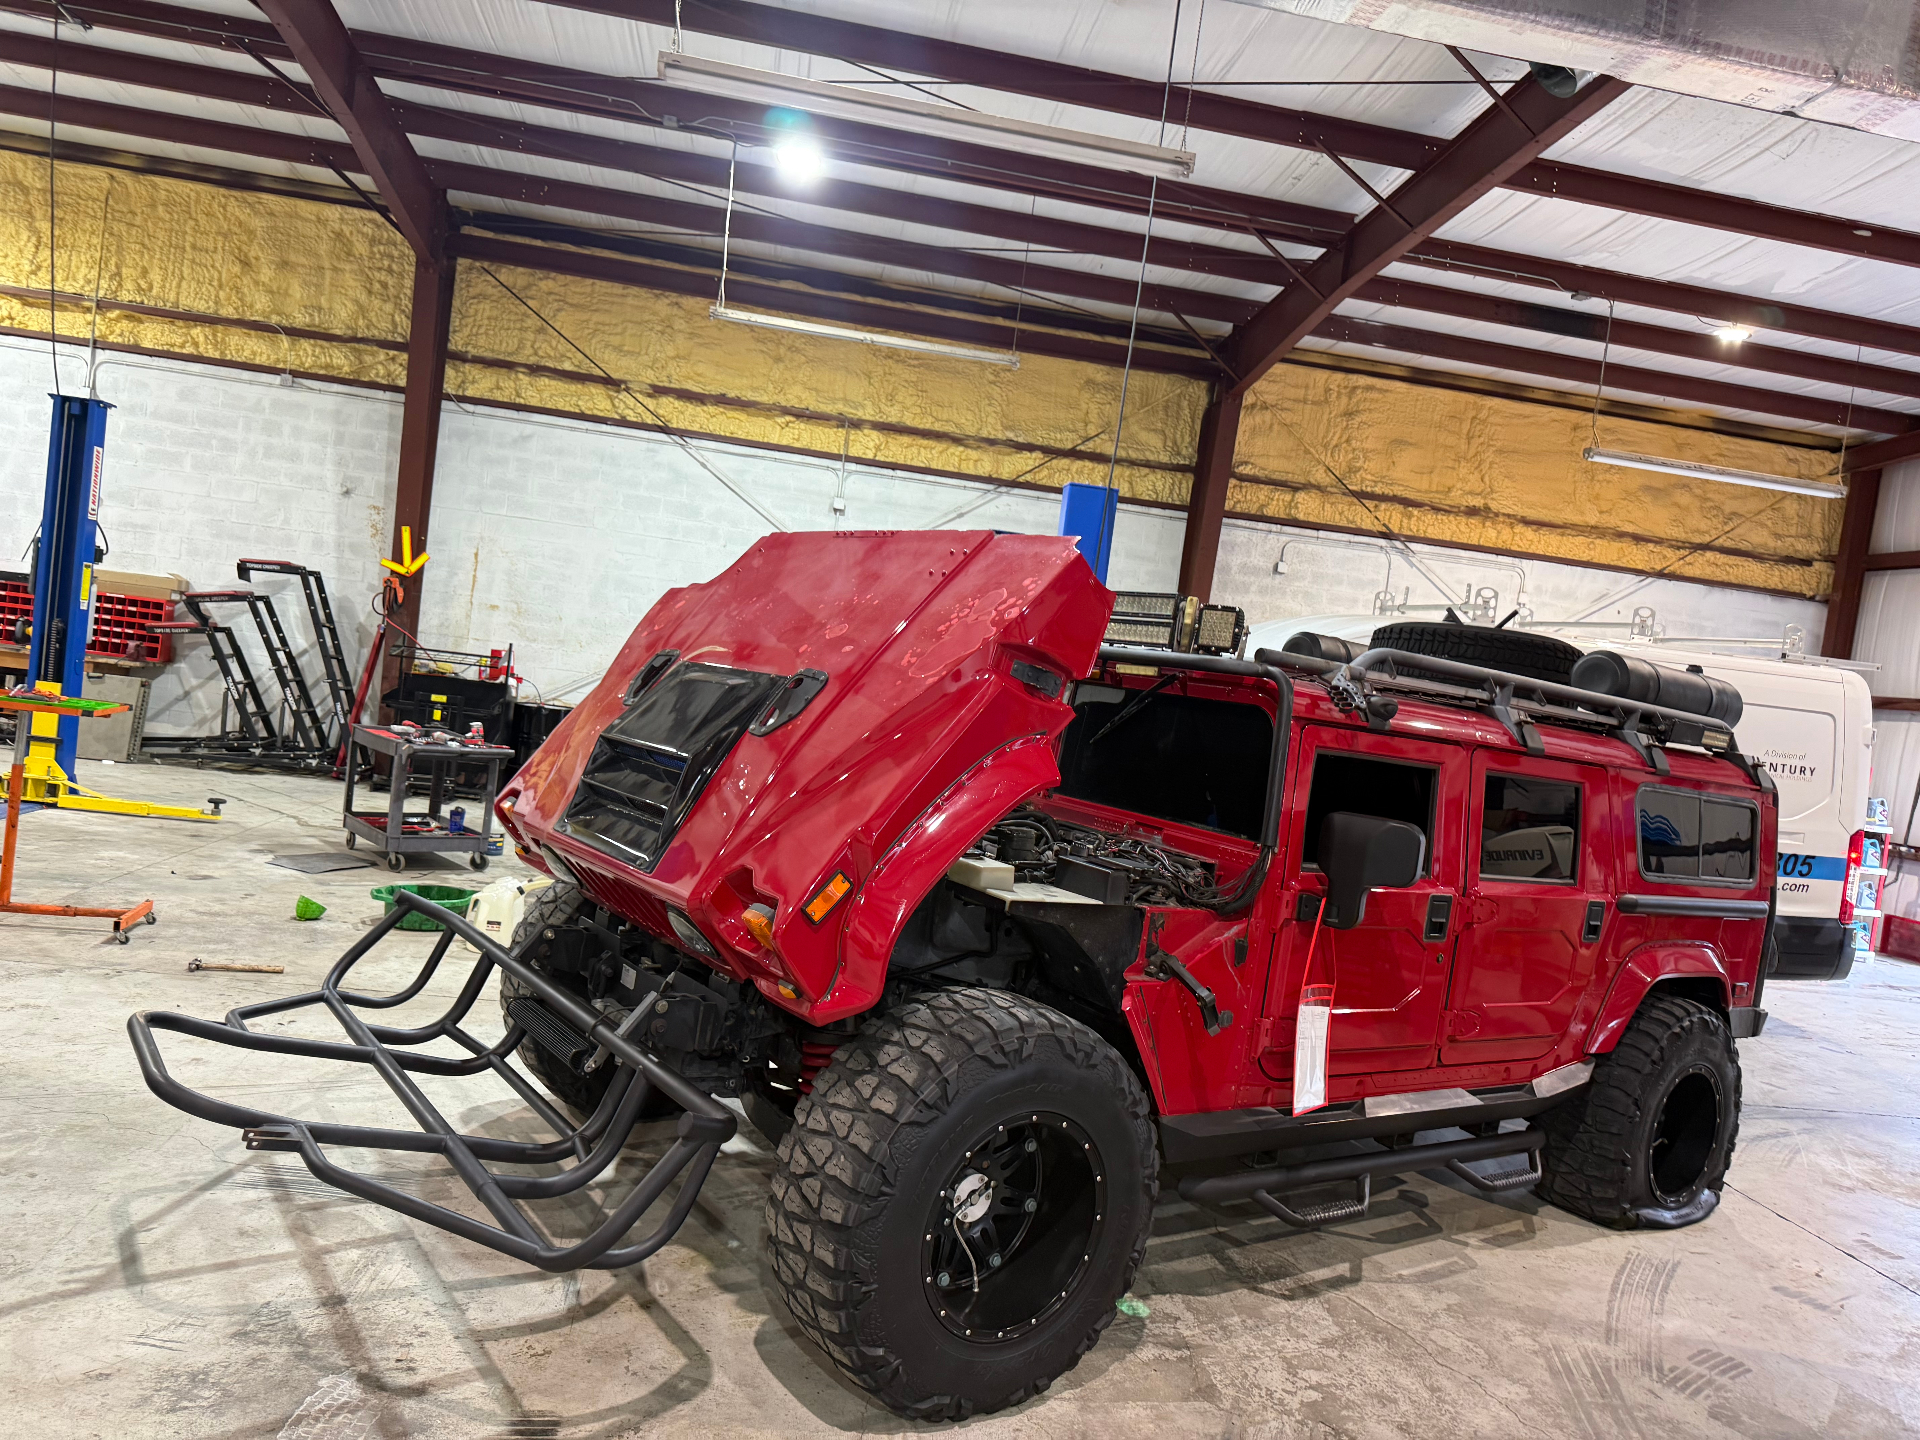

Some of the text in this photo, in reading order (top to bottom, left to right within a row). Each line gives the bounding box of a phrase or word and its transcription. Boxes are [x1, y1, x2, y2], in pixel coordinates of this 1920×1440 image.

[91, 448, 101, 507] NATIONWIDE
[1763, 749, 1807, 761] A Division of
[1762, 761, 1816, 777] ENTURY
